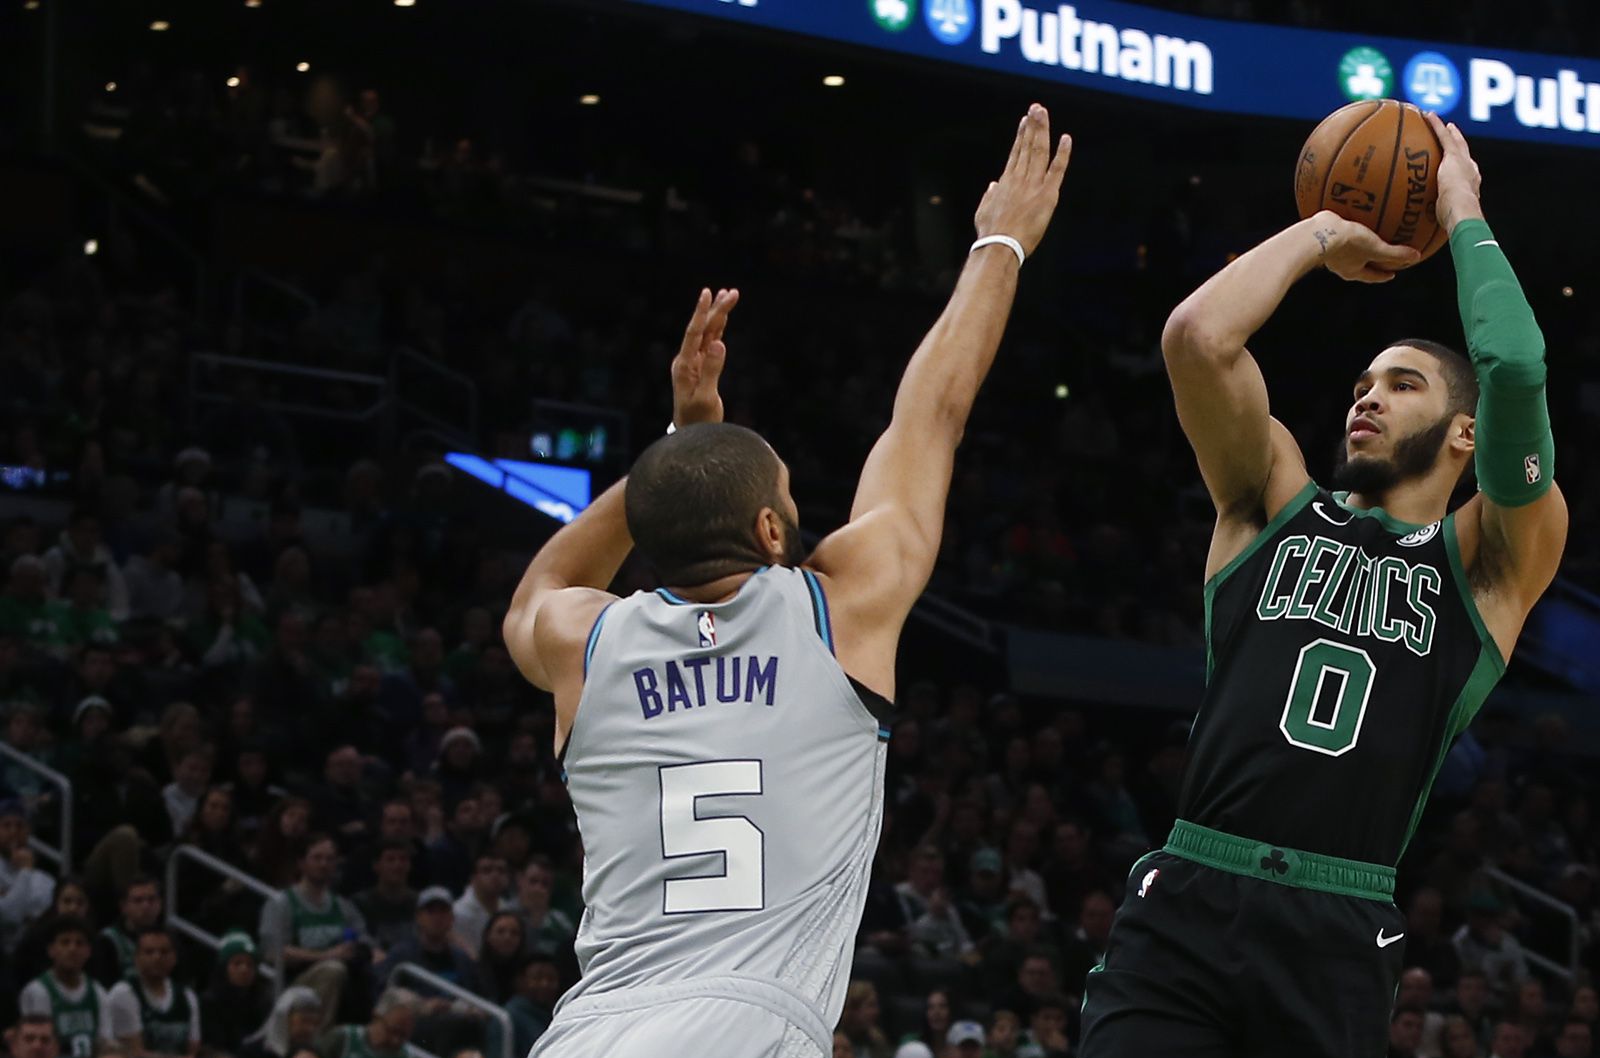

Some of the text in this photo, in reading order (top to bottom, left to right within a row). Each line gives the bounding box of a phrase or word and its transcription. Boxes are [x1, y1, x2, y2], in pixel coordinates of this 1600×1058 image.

[981, 0, 1213, 95] Putnam
[1256, 535, 1441, 656] CELTICS
[633, 656, 778, 720] BATUM
[1279, 638, 1377, 757] 0
[658, 759, 765, 915] 5
